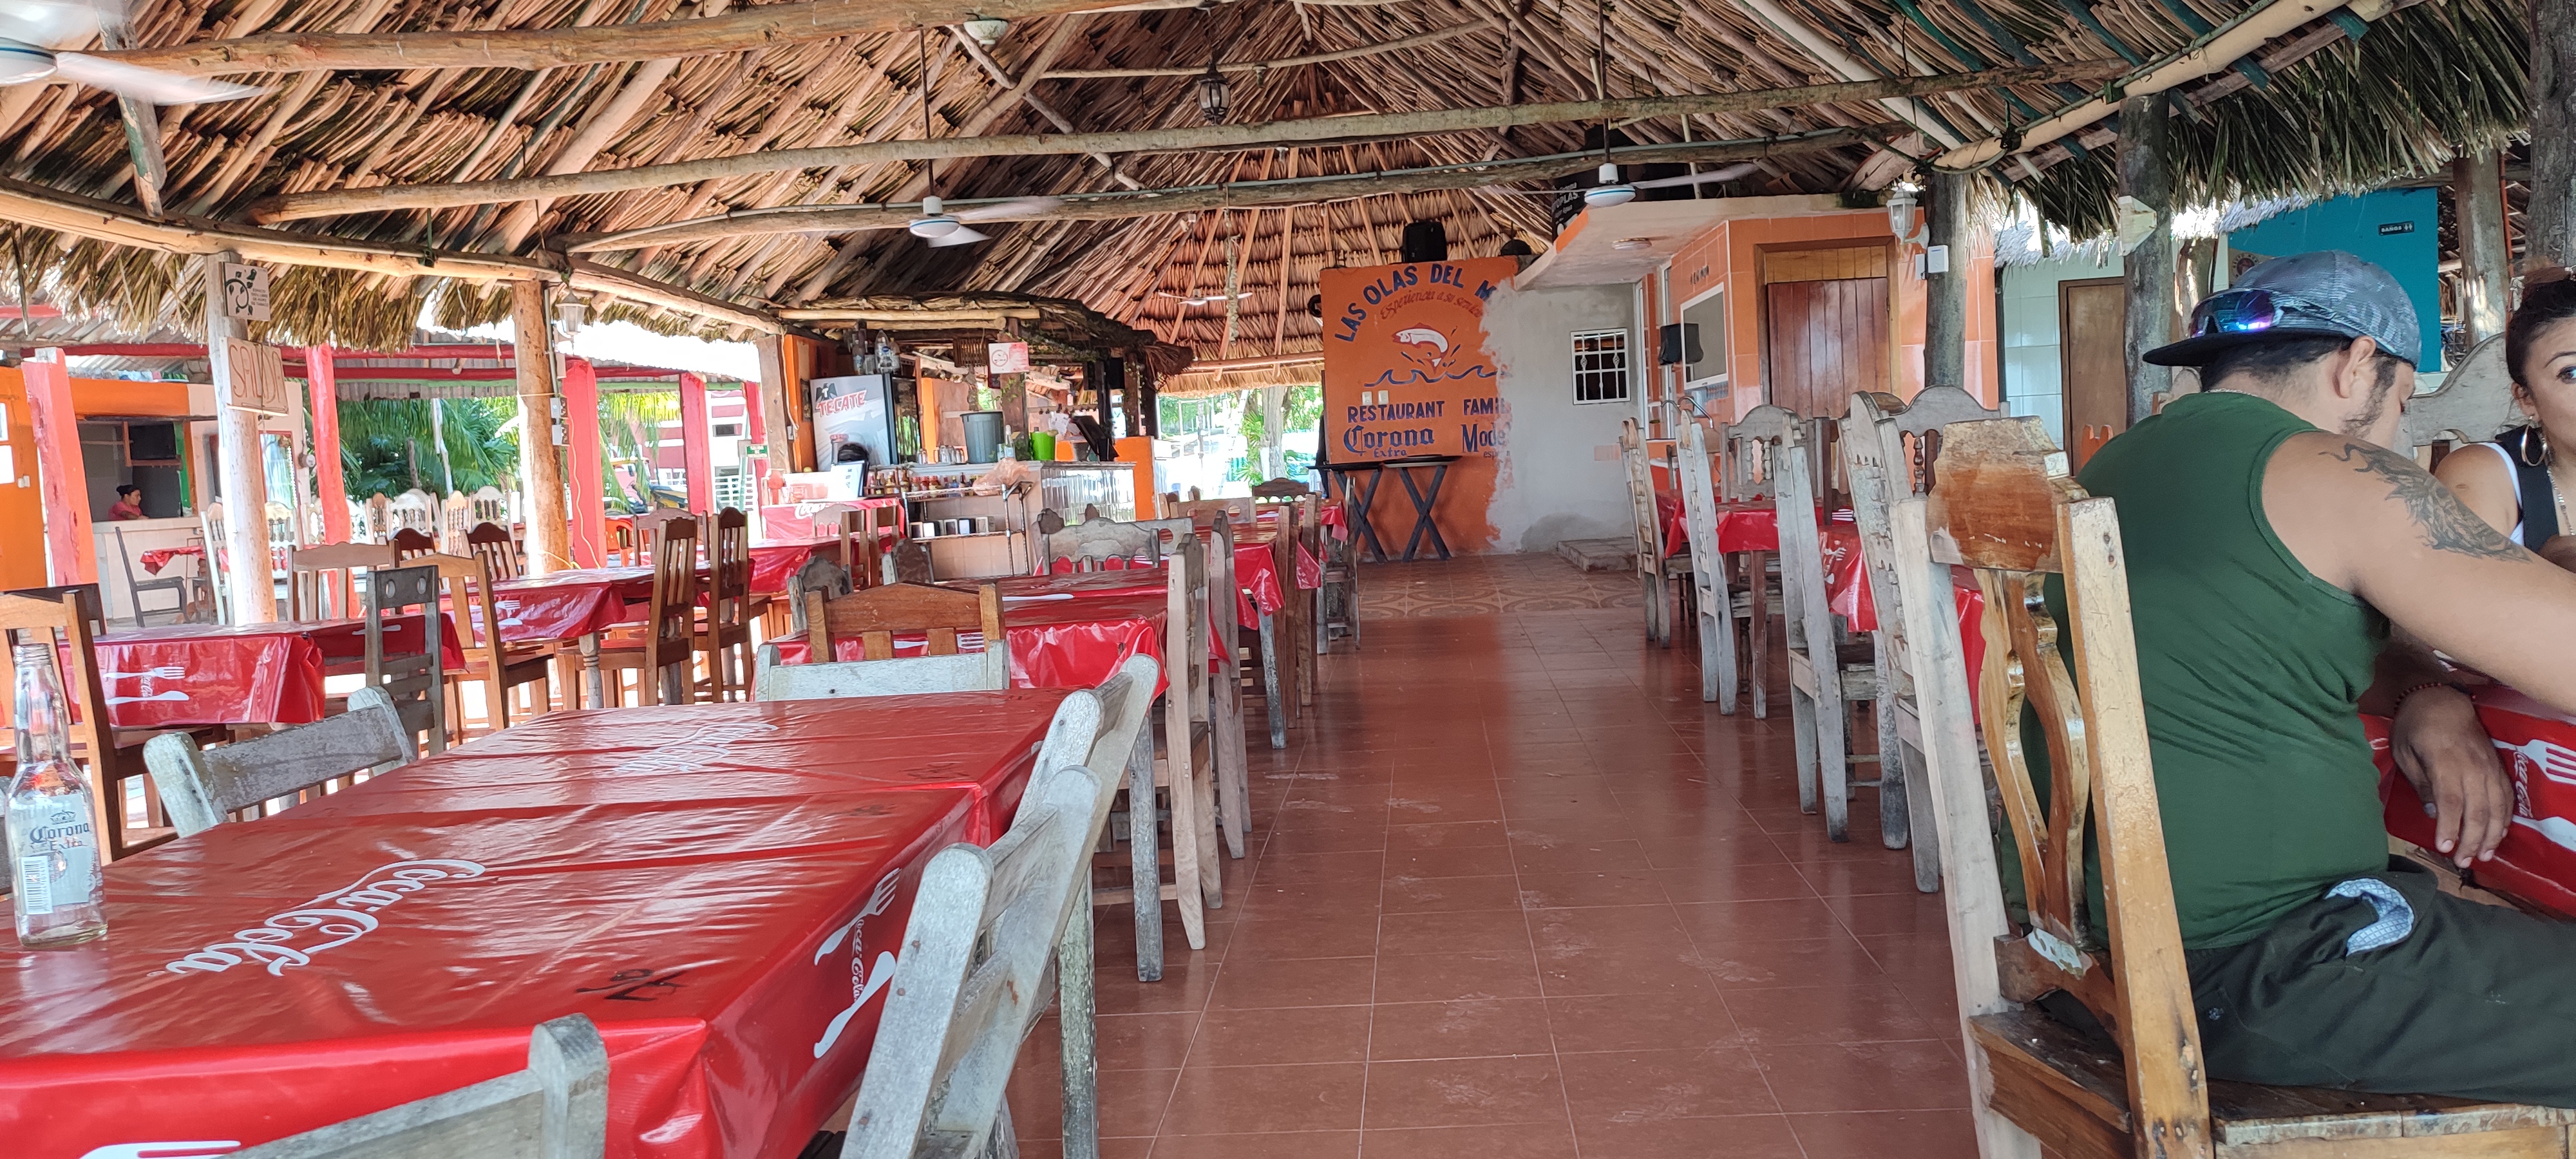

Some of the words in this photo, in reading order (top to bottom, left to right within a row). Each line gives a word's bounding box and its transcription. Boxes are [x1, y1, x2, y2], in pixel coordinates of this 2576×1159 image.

[1334, 302, 1367, 342] LAS
[1363, 265, 1418, 305] OLAS
[1430, 263, 1464, 288] DEL
[229, 344, 289, 403] SALIDA
[816, 390, 867, 417] TECATE
[1347, 400, 1445, 424] RESTAURANT
[1343, 425, 1435, 457] Corona
[1374, 448, 1407, 458] Extra
[30, 822, 90, 843] Corona
